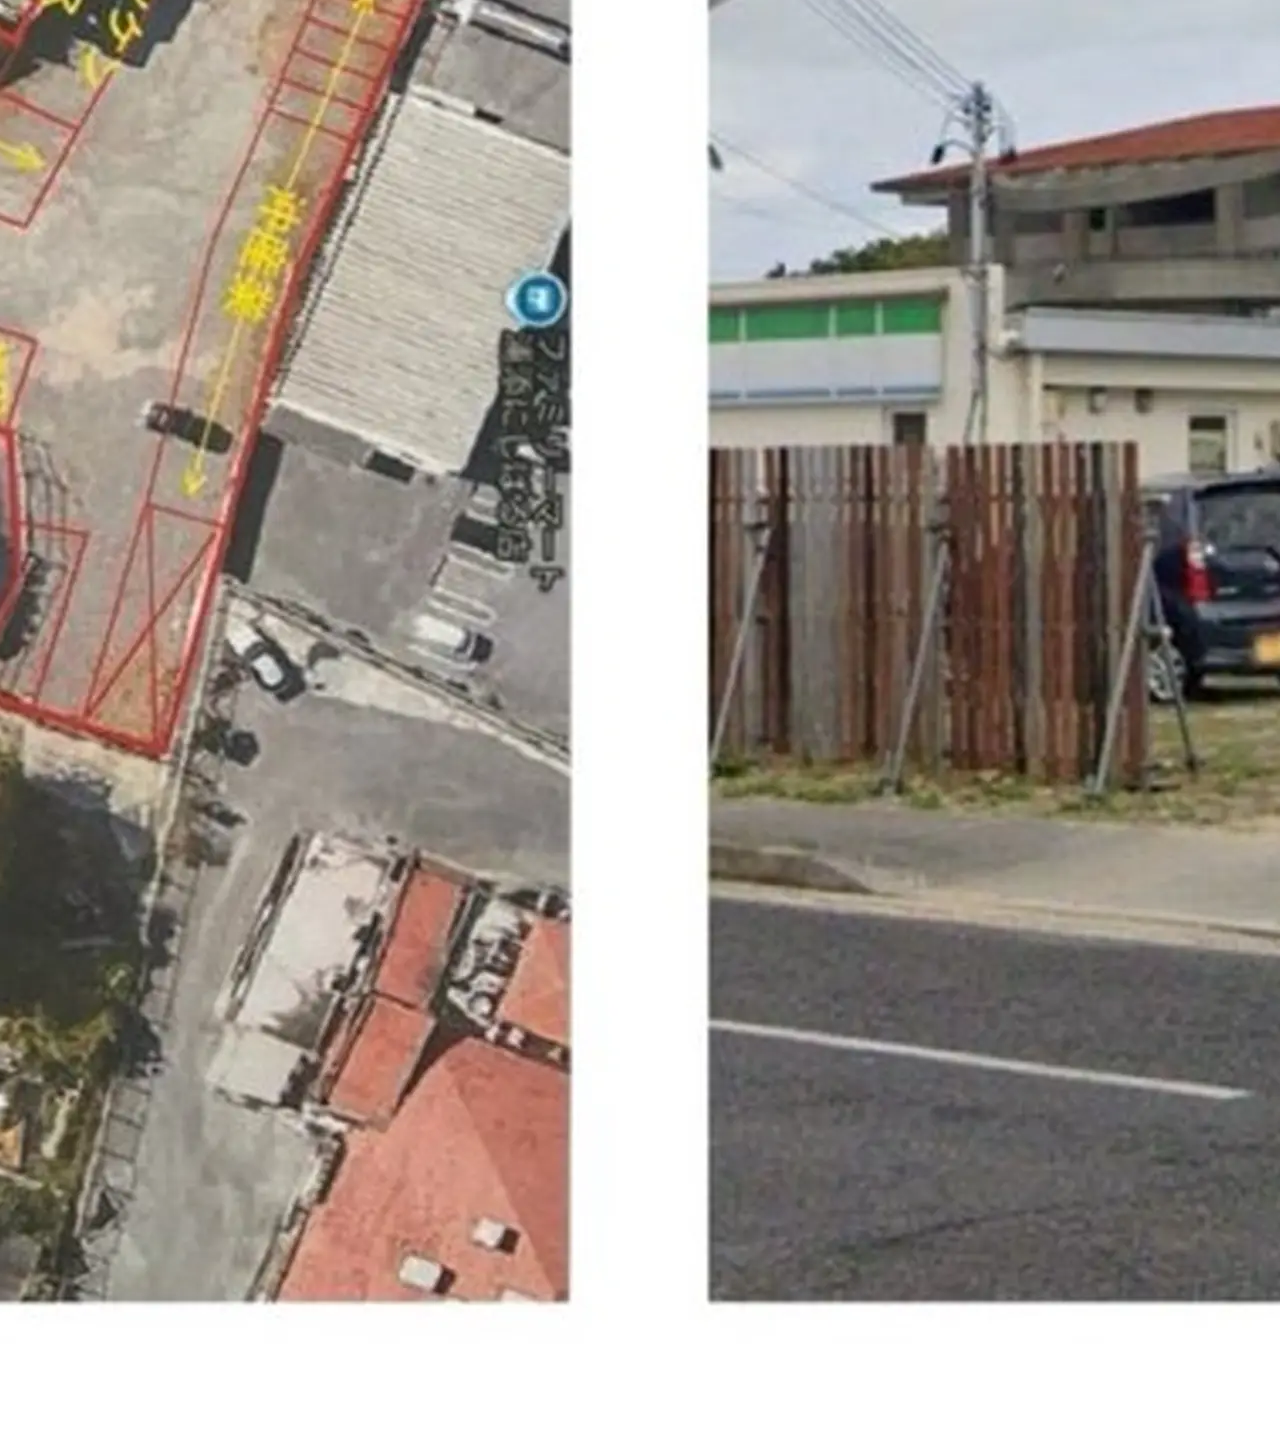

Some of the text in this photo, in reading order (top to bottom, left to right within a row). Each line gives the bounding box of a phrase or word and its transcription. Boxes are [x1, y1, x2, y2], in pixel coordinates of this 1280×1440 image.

[528, 336, 567, 595] ファミリーマート
